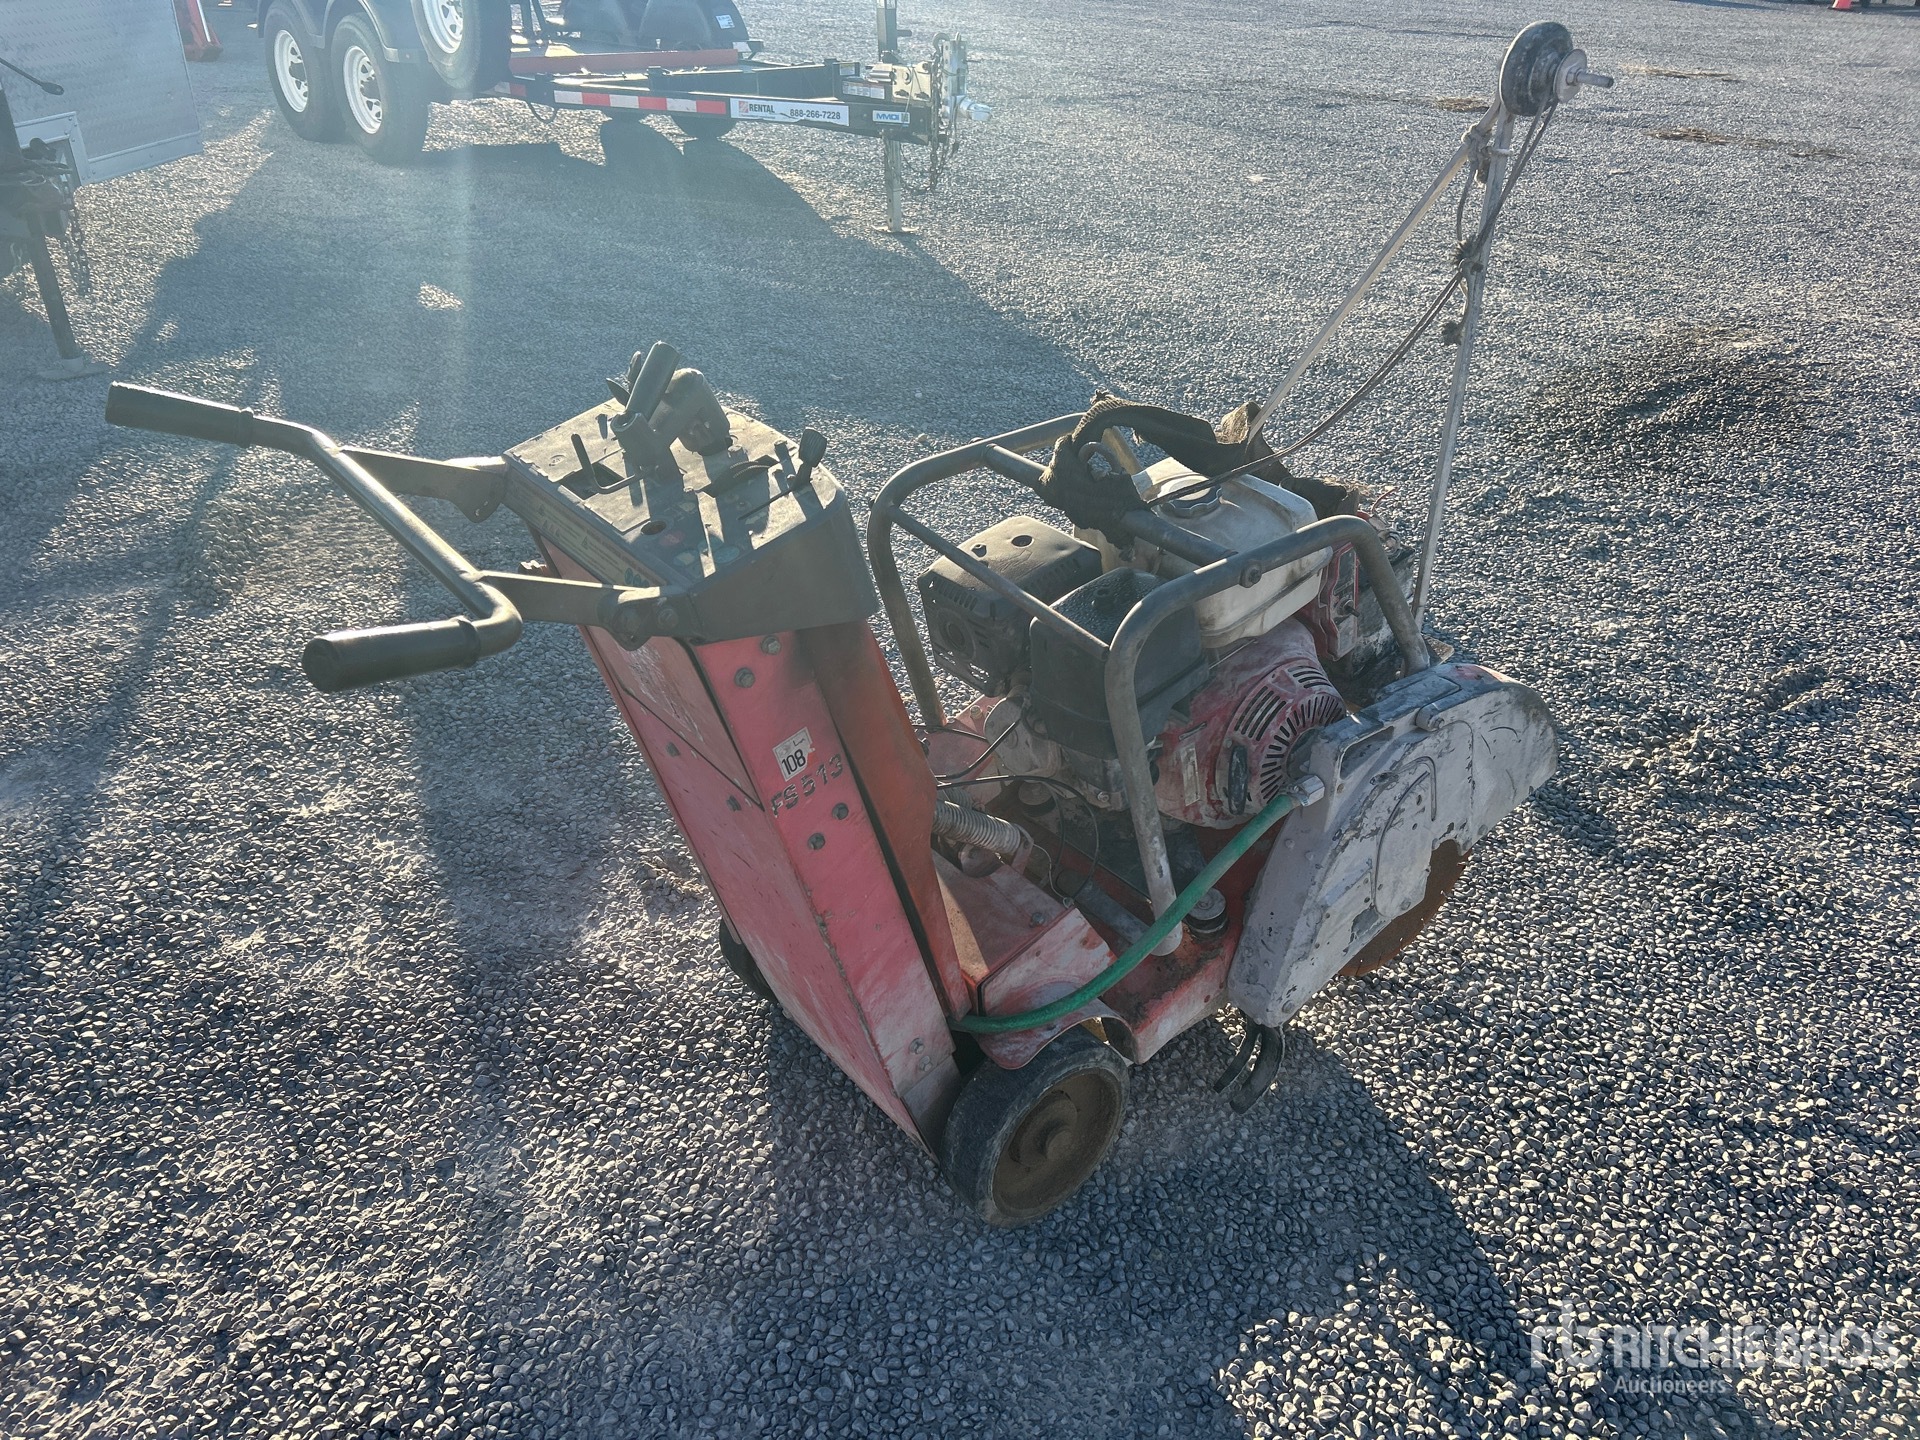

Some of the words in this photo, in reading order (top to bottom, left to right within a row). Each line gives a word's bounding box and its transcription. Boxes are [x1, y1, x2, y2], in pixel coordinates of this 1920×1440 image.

[748, 103, 776, 114] RENTAL
[789, 108, 841, 120] 888-266-7228
[781, 748, 807, 775] 108
